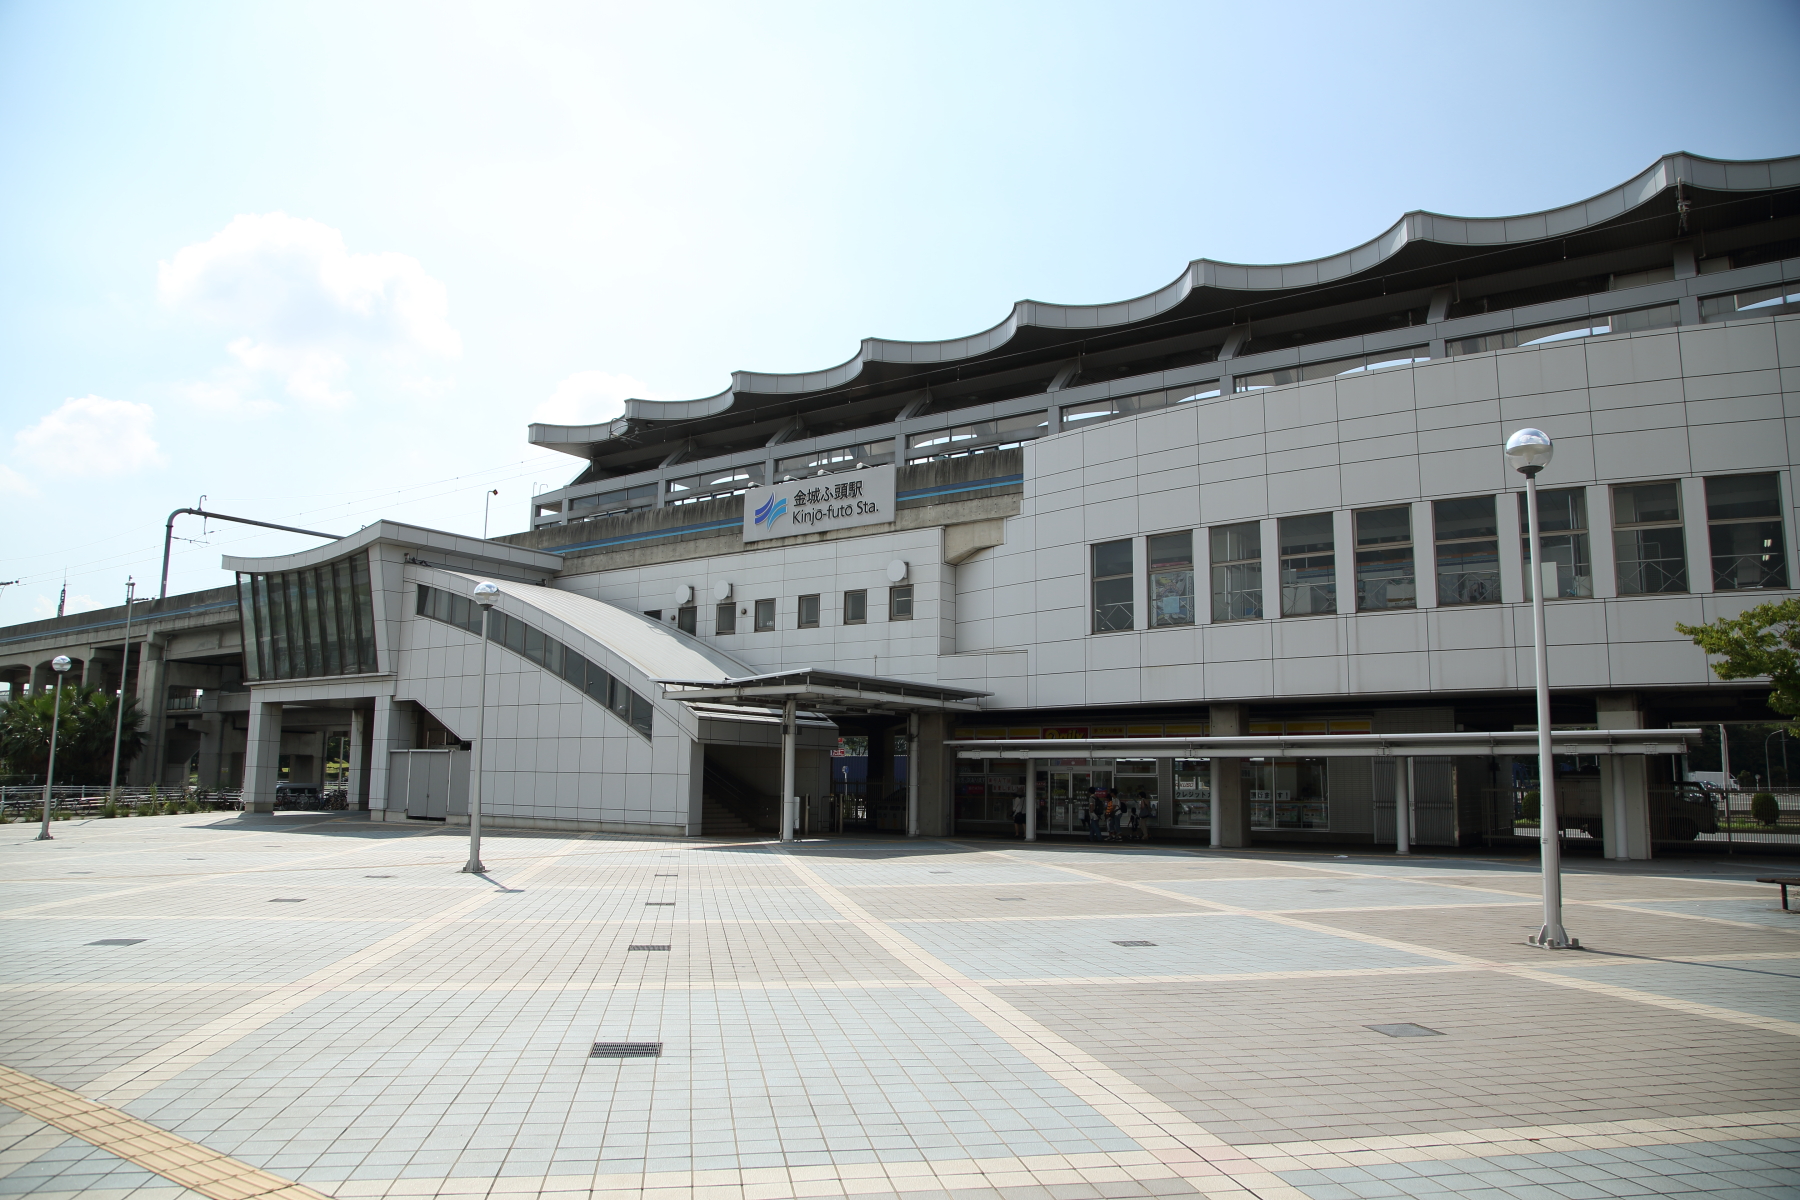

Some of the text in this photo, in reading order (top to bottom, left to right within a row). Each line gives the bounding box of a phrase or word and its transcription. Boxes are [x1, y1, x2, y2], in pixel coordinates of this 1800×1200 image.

[793, 480, 864, 507] 金城ふ頭駅
[792, 501, 879, 526] Kinjō-futō Sta.
